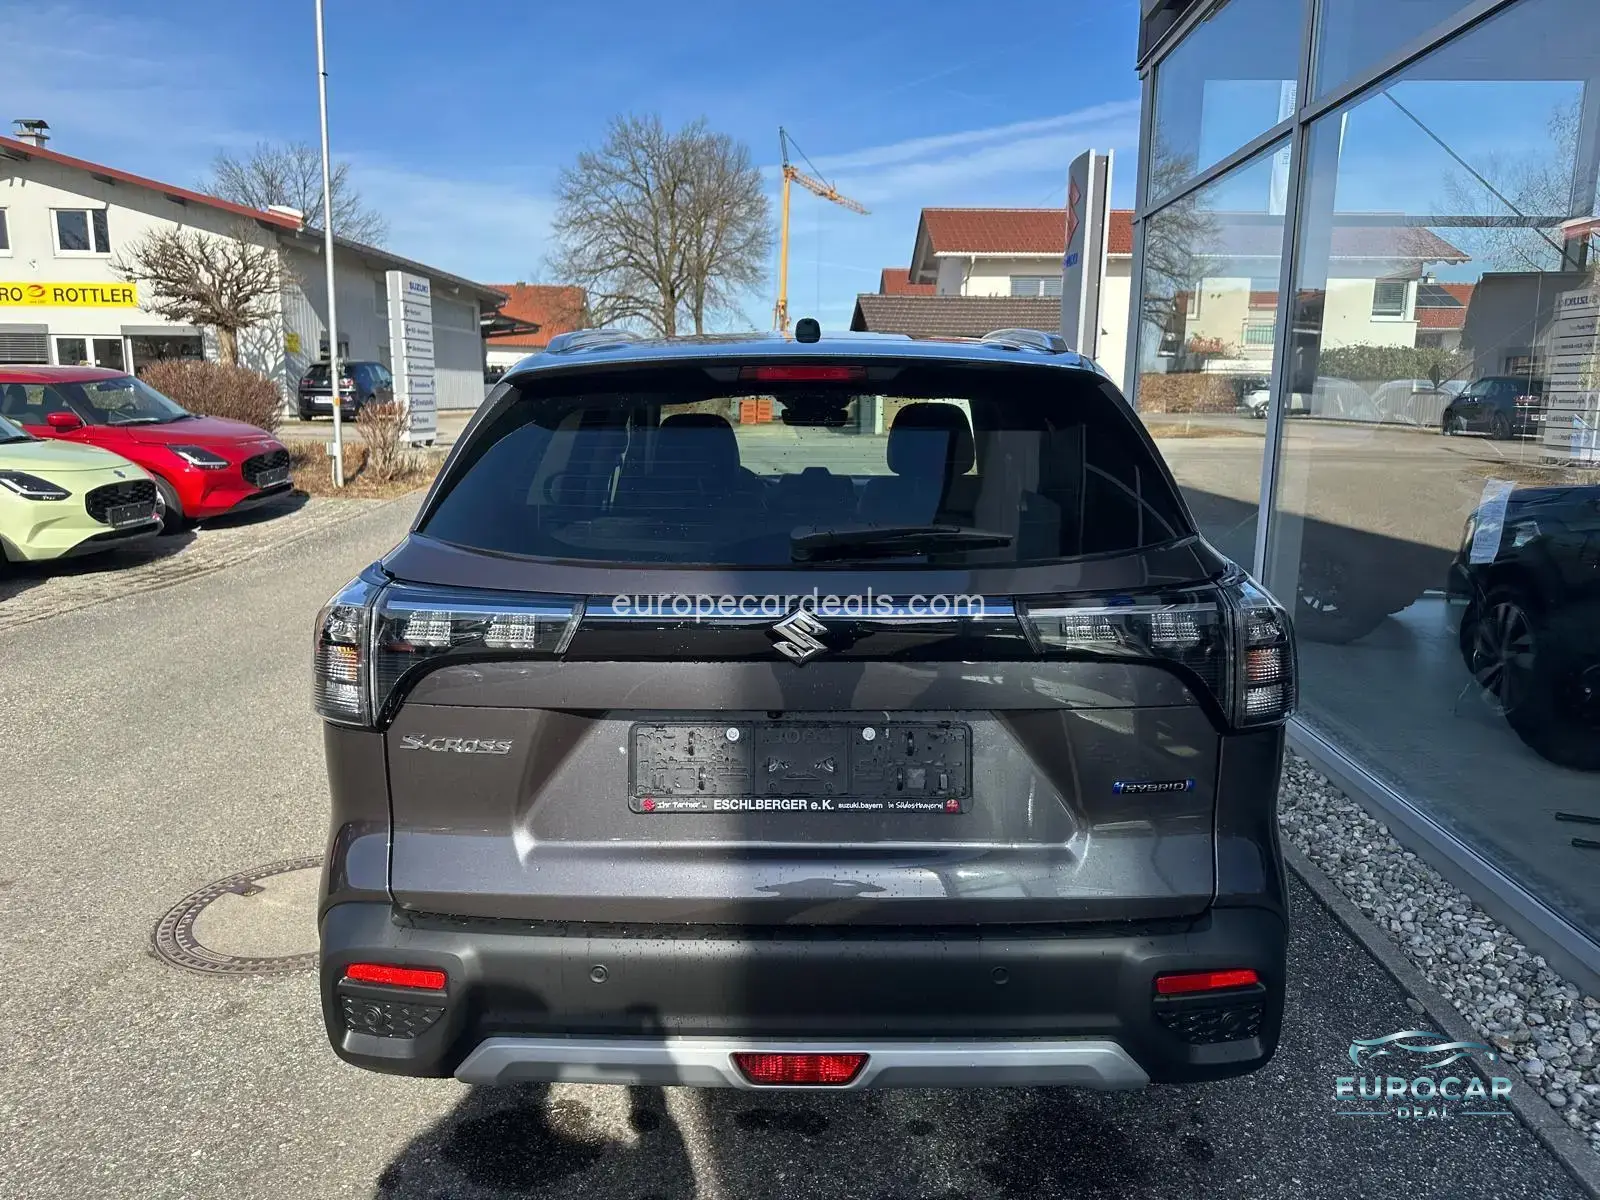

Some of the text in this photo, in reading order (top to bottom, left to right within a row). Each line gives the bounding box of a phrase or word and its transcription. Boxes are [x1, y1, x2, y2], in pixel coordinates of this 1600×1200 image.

[53, 288, 133, 302] ROTTLER
[1125, 782, 1184, 793] HYBRID
[713, 799, 807, 810] ESCHLBERGER
[810, 800, 834, 810] e.K.
